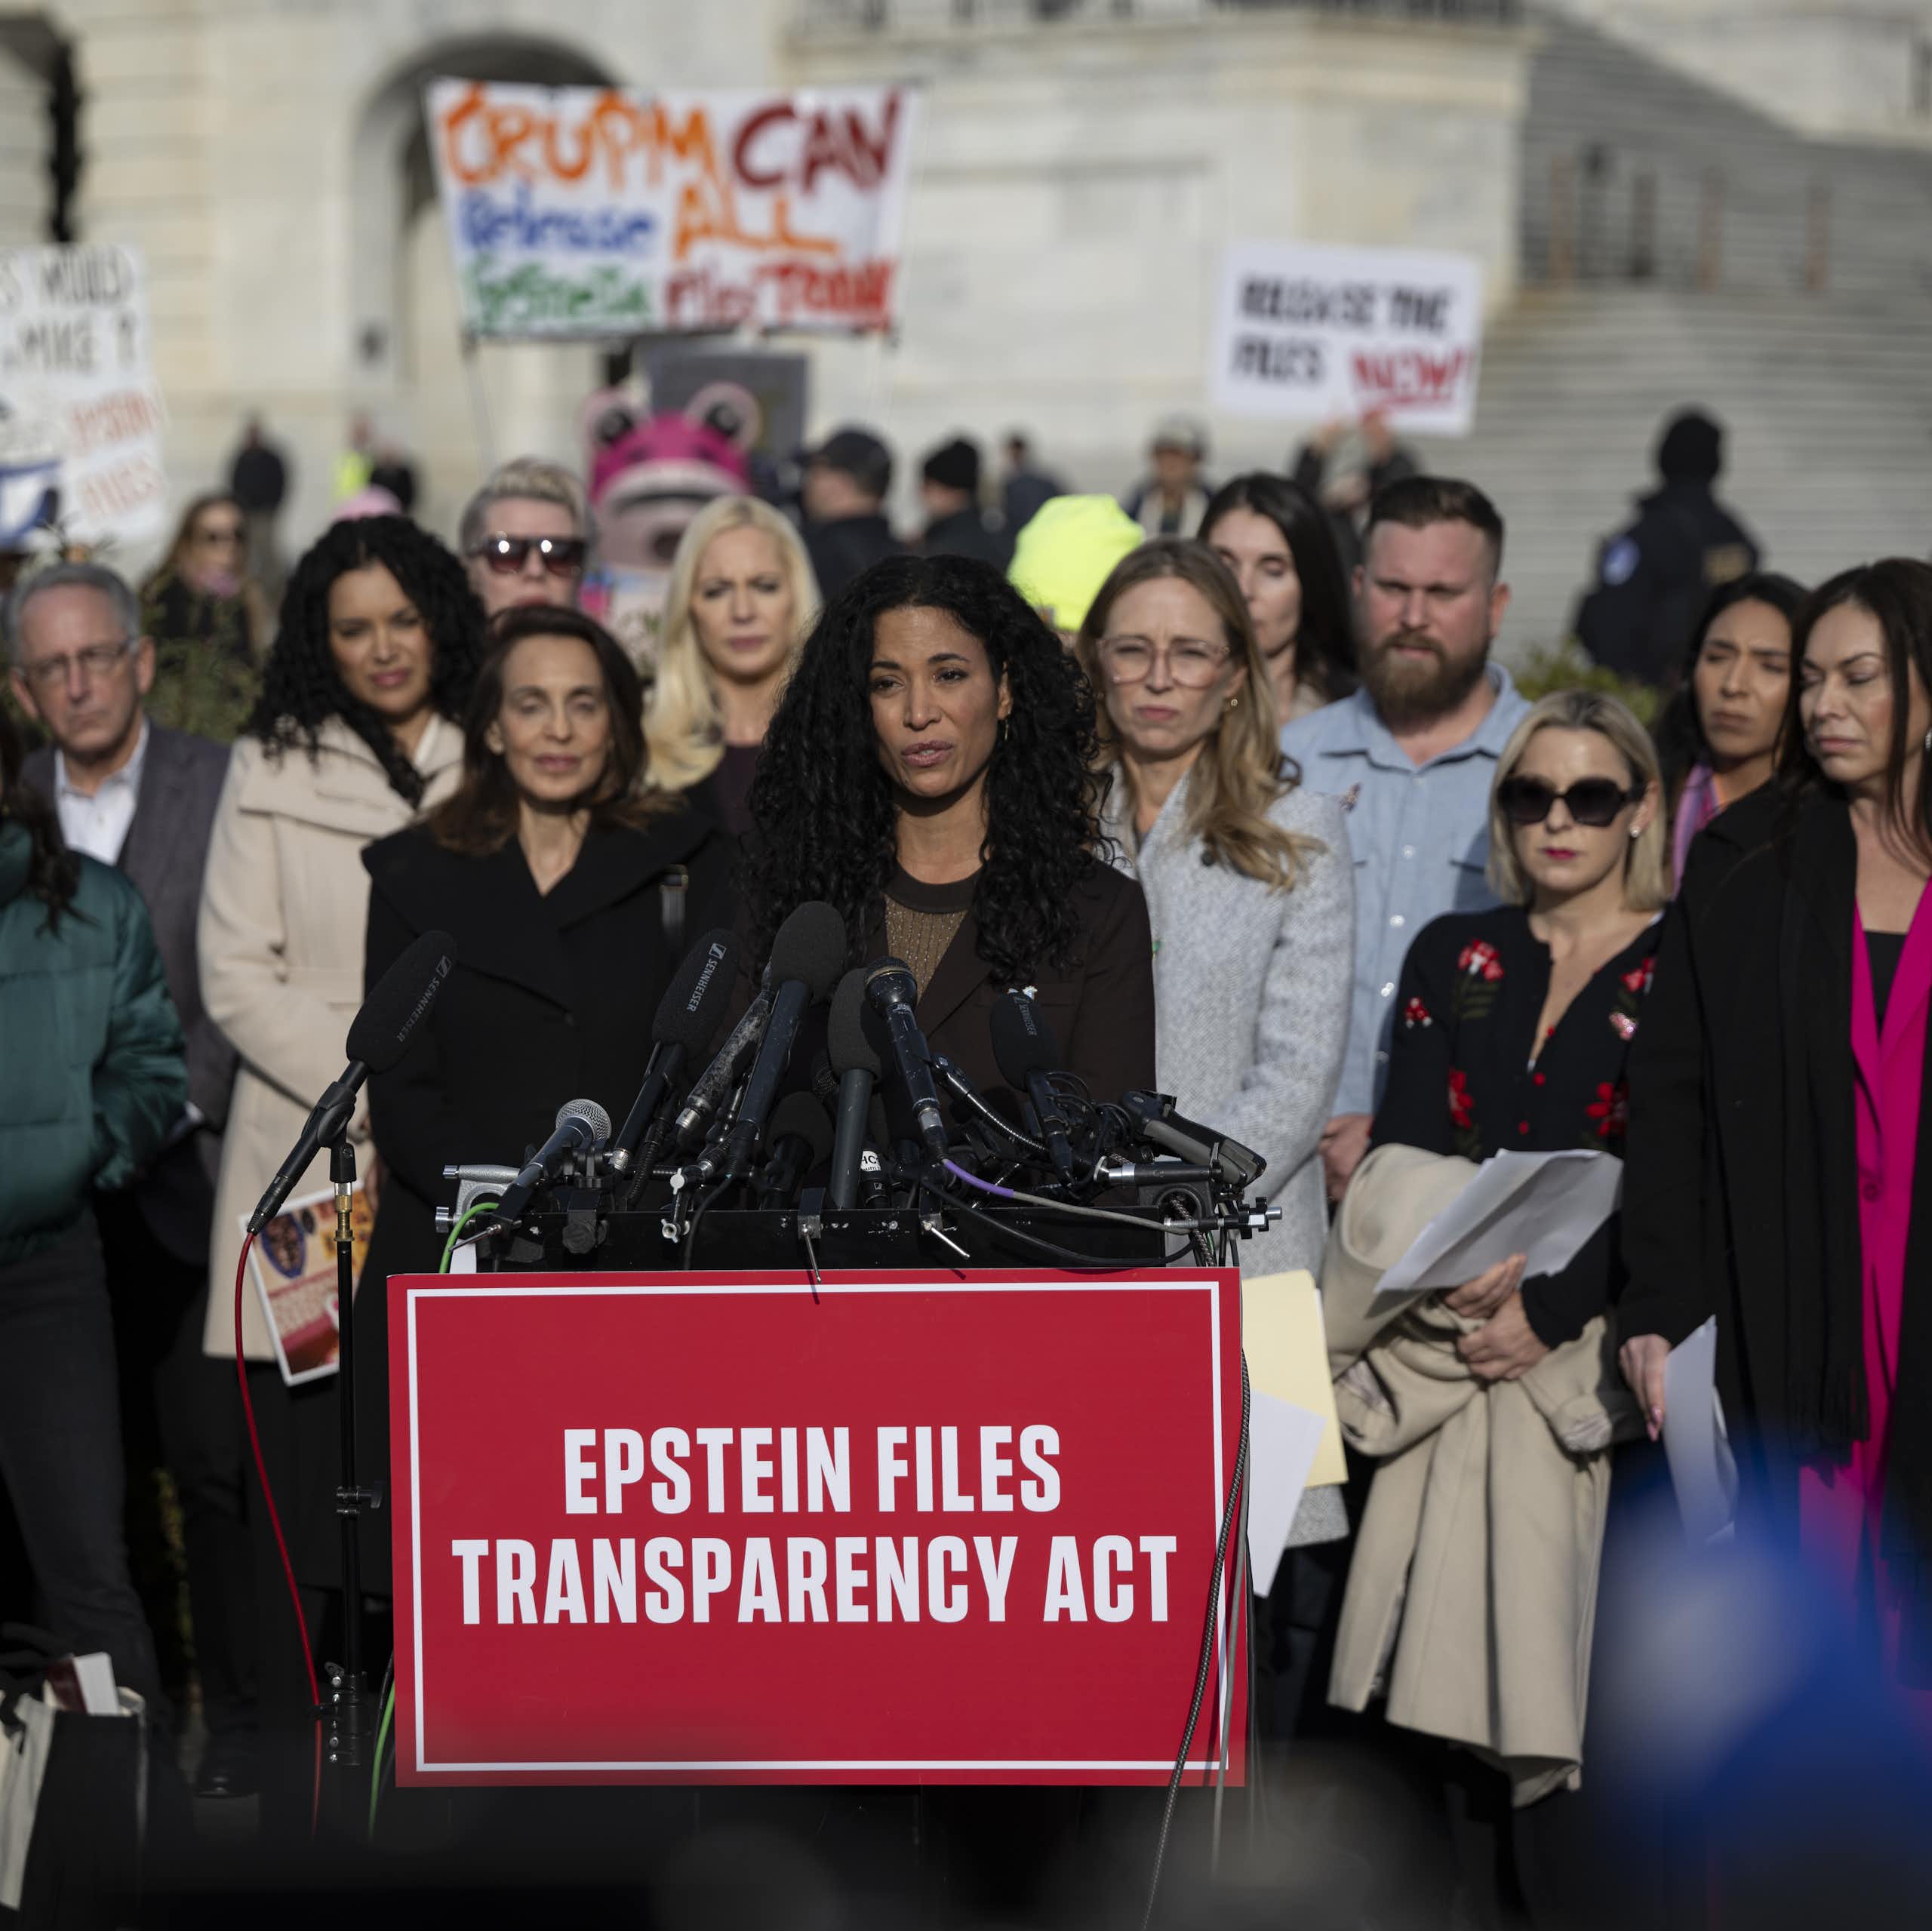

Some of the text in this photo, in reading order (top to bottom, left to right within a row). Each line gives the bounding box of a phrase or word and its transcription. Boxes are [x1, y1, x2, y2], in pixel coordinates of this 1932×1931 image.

[732, 88, 903, 195] CAN
[1240, 276, 1452, 335] RELEASE THE
[1232, 337, 1327, 385] FILES
[397, 976, 441, 1042] SENNHEISER
[685, 958, 718, 1012] SENNHEISER
[565, 1425, 1060, 1514] EPSTEIN FILES
[452, 1536, 1177, 1624] TRANSPARENCY ACT
